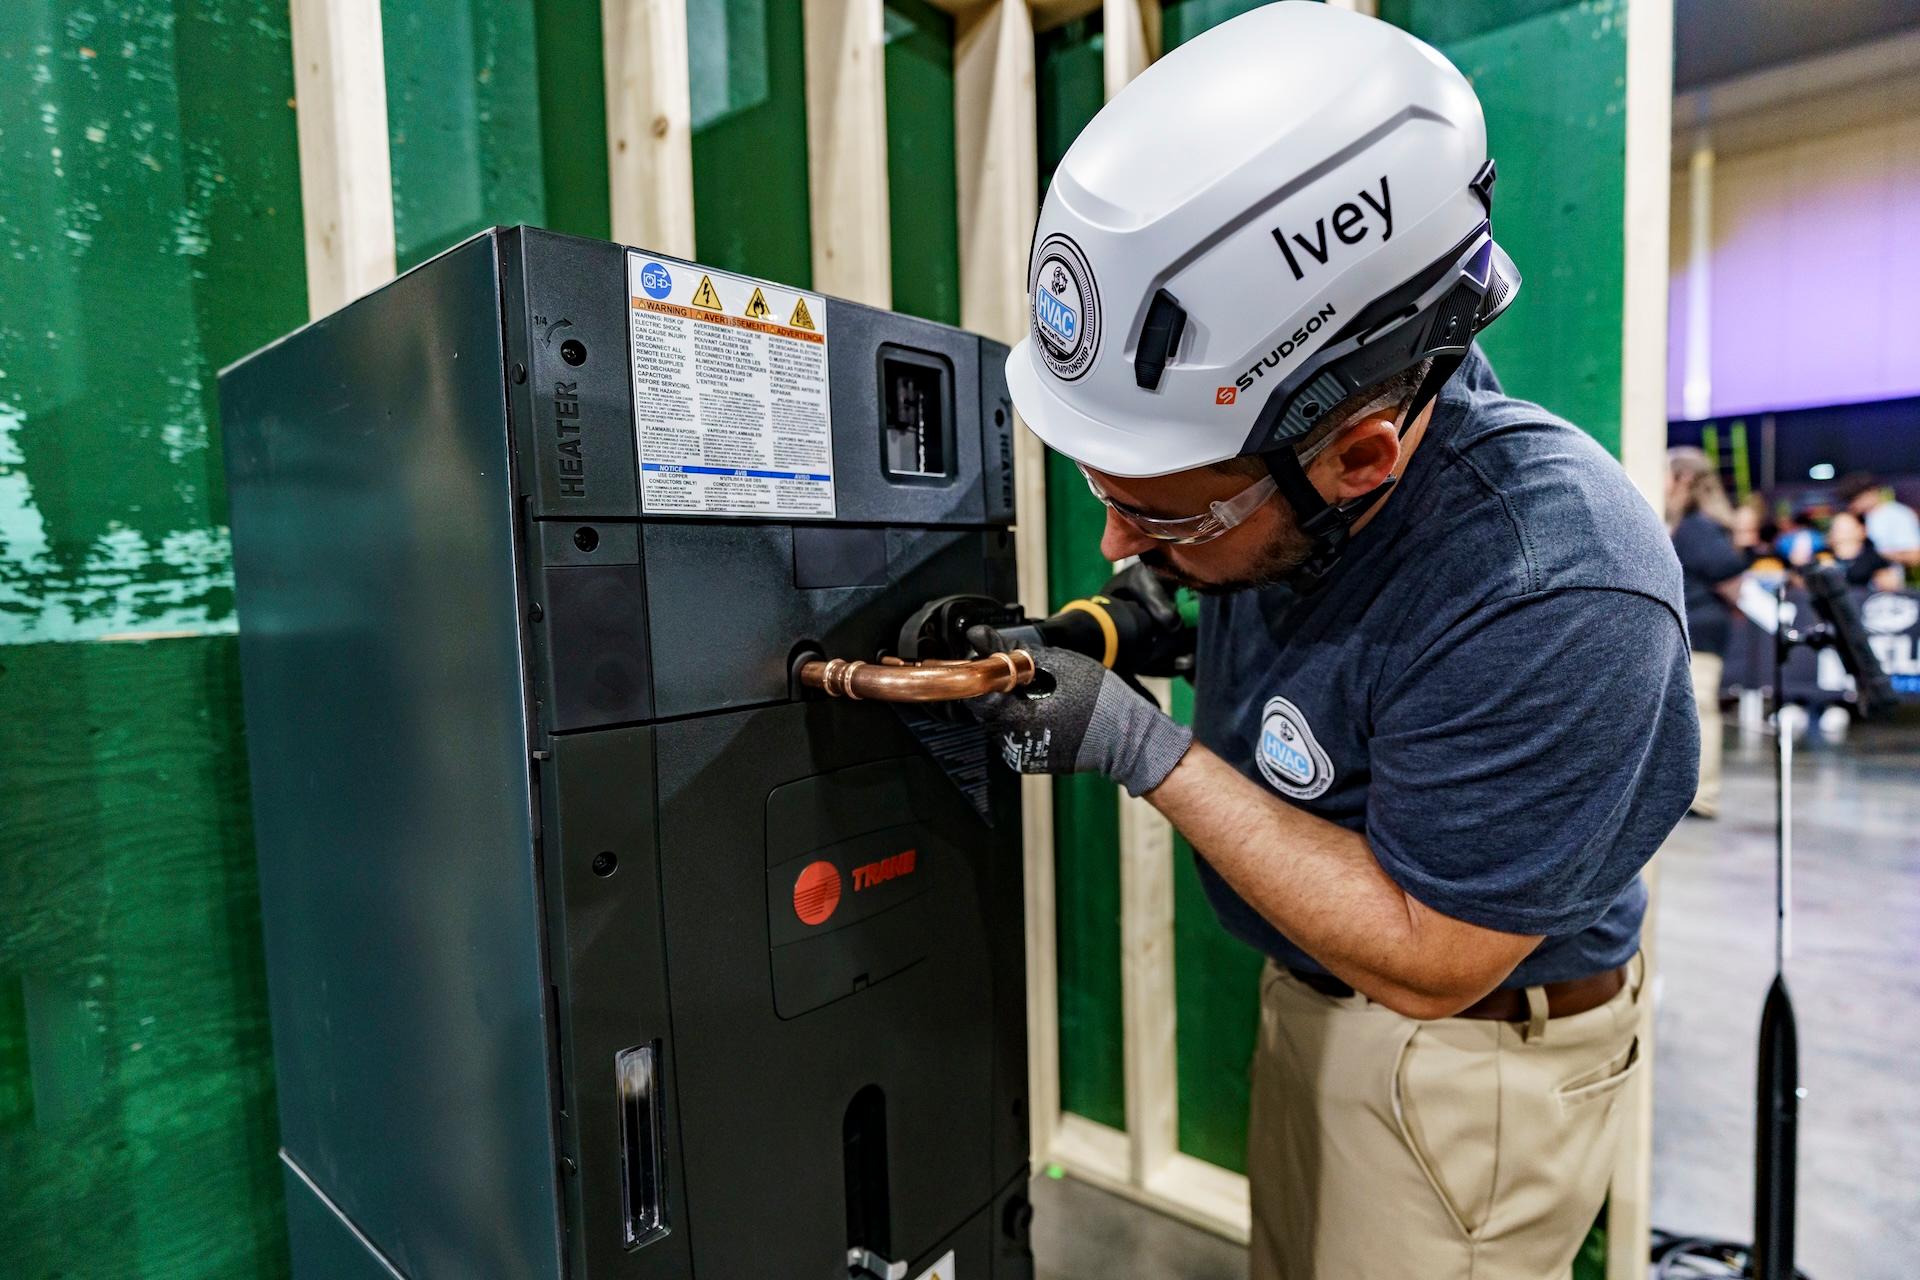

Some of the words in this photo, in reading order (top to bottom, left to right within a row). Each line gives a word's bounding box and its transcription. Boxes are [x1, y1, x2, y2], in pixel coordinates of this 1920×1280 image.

[1271, 175, 1393, 281] Ivey
[647, 302, 687, 317] WARNING
[1039, 289, 1073, 337] HVAC
[635, 319, 661, 328] ELECTRIC
[704, 314, 766, 331] AVERTISSEMENT
[636, 341, 670, 351] DISCONNECT
[695, 344, 724, 353] BLESSURES
[1236, 303, 1336, 392] STUDSON
[660, 352, 686, 360] ELECTRIC
[1045, 347, 1089, 374] CHAMPIONSHIP
[659, 359, 683, 367] SUPPLIES
[696, 358, 734, 368] ALIMENTATIONS
[650, 365, 680, 374] DISCHARGE
[703, 366, 746, 376] CONDENSATEURS
[638, 371, 672, 379] CAPACITORS
[554, 382, 586, 498] HEATER
[1266, 735, 1306, 774] HVAC
